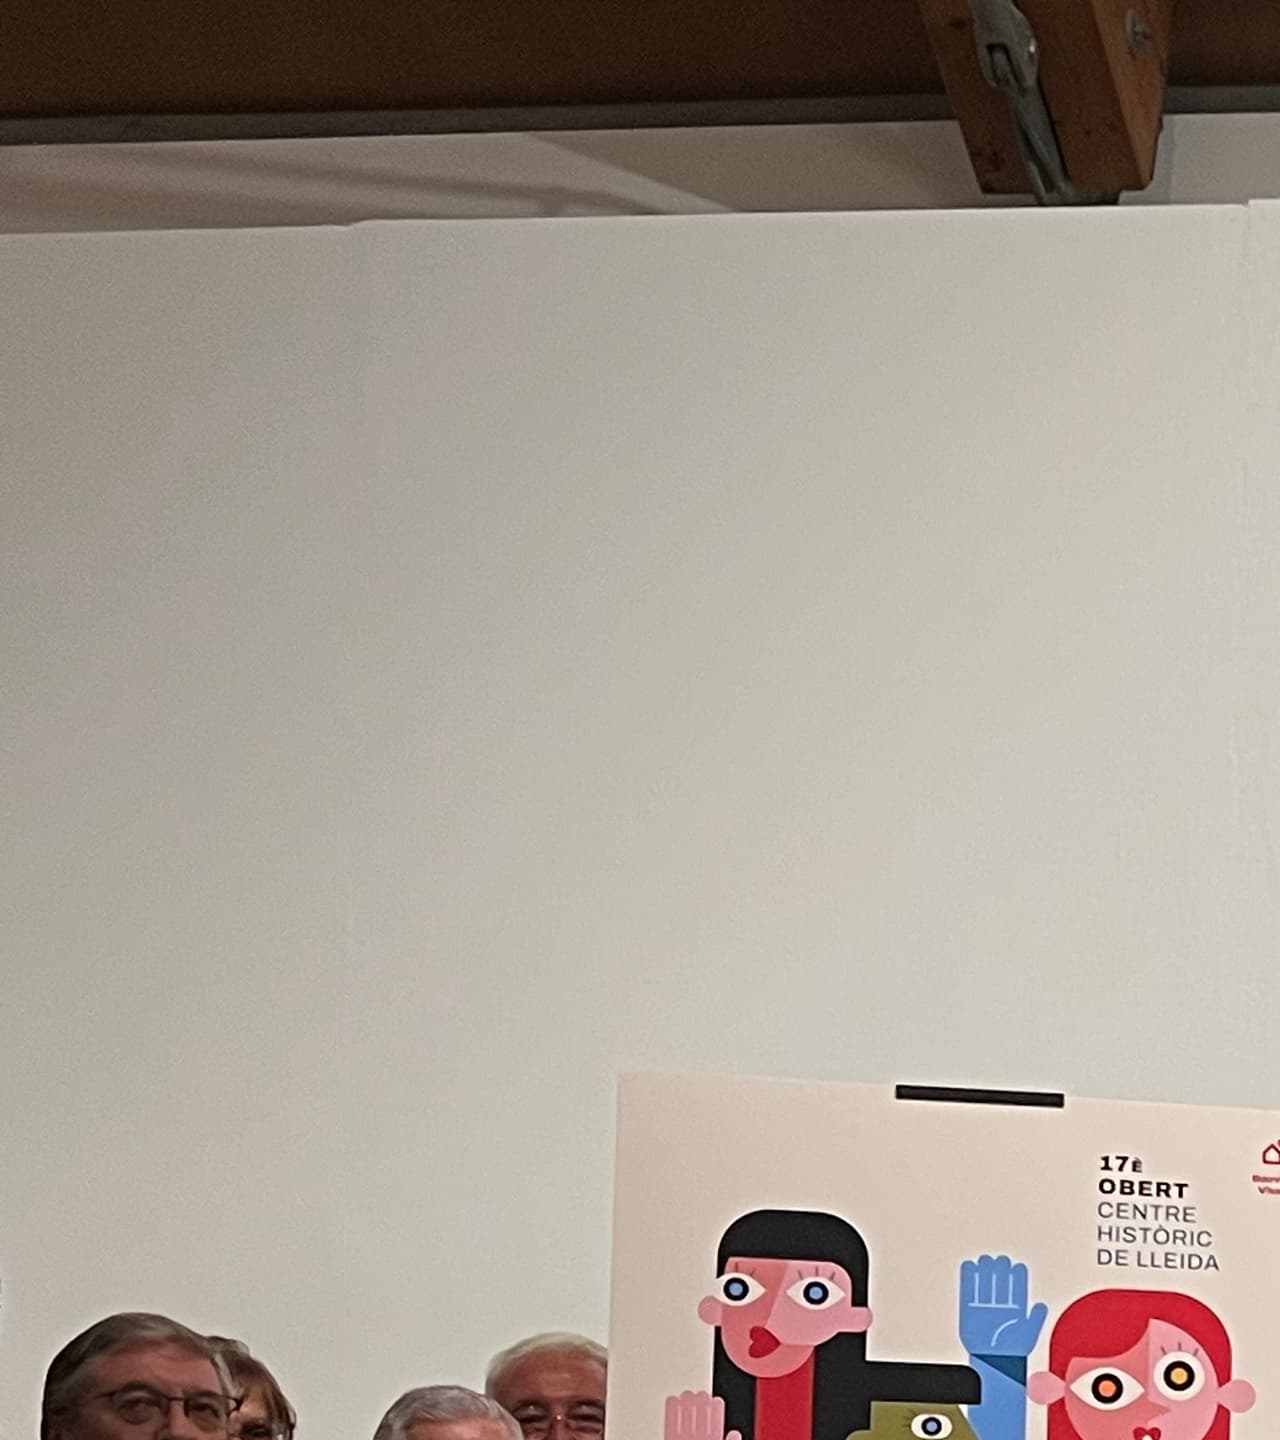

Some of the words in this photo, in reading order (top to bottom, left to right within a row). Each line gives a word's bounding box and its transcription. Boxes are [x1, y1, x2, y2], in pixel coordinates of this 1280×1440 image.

[1098, 1177, 1189, 1199] OBERT
[1097, 1201, 1198, 1224] CENTRE
[1097, 1223, 1213, 1248] HISTÒRIC
[1096, 1248, 1129, 1267] DE
[1136, 1250, 1221, 1272] LLEIDA
